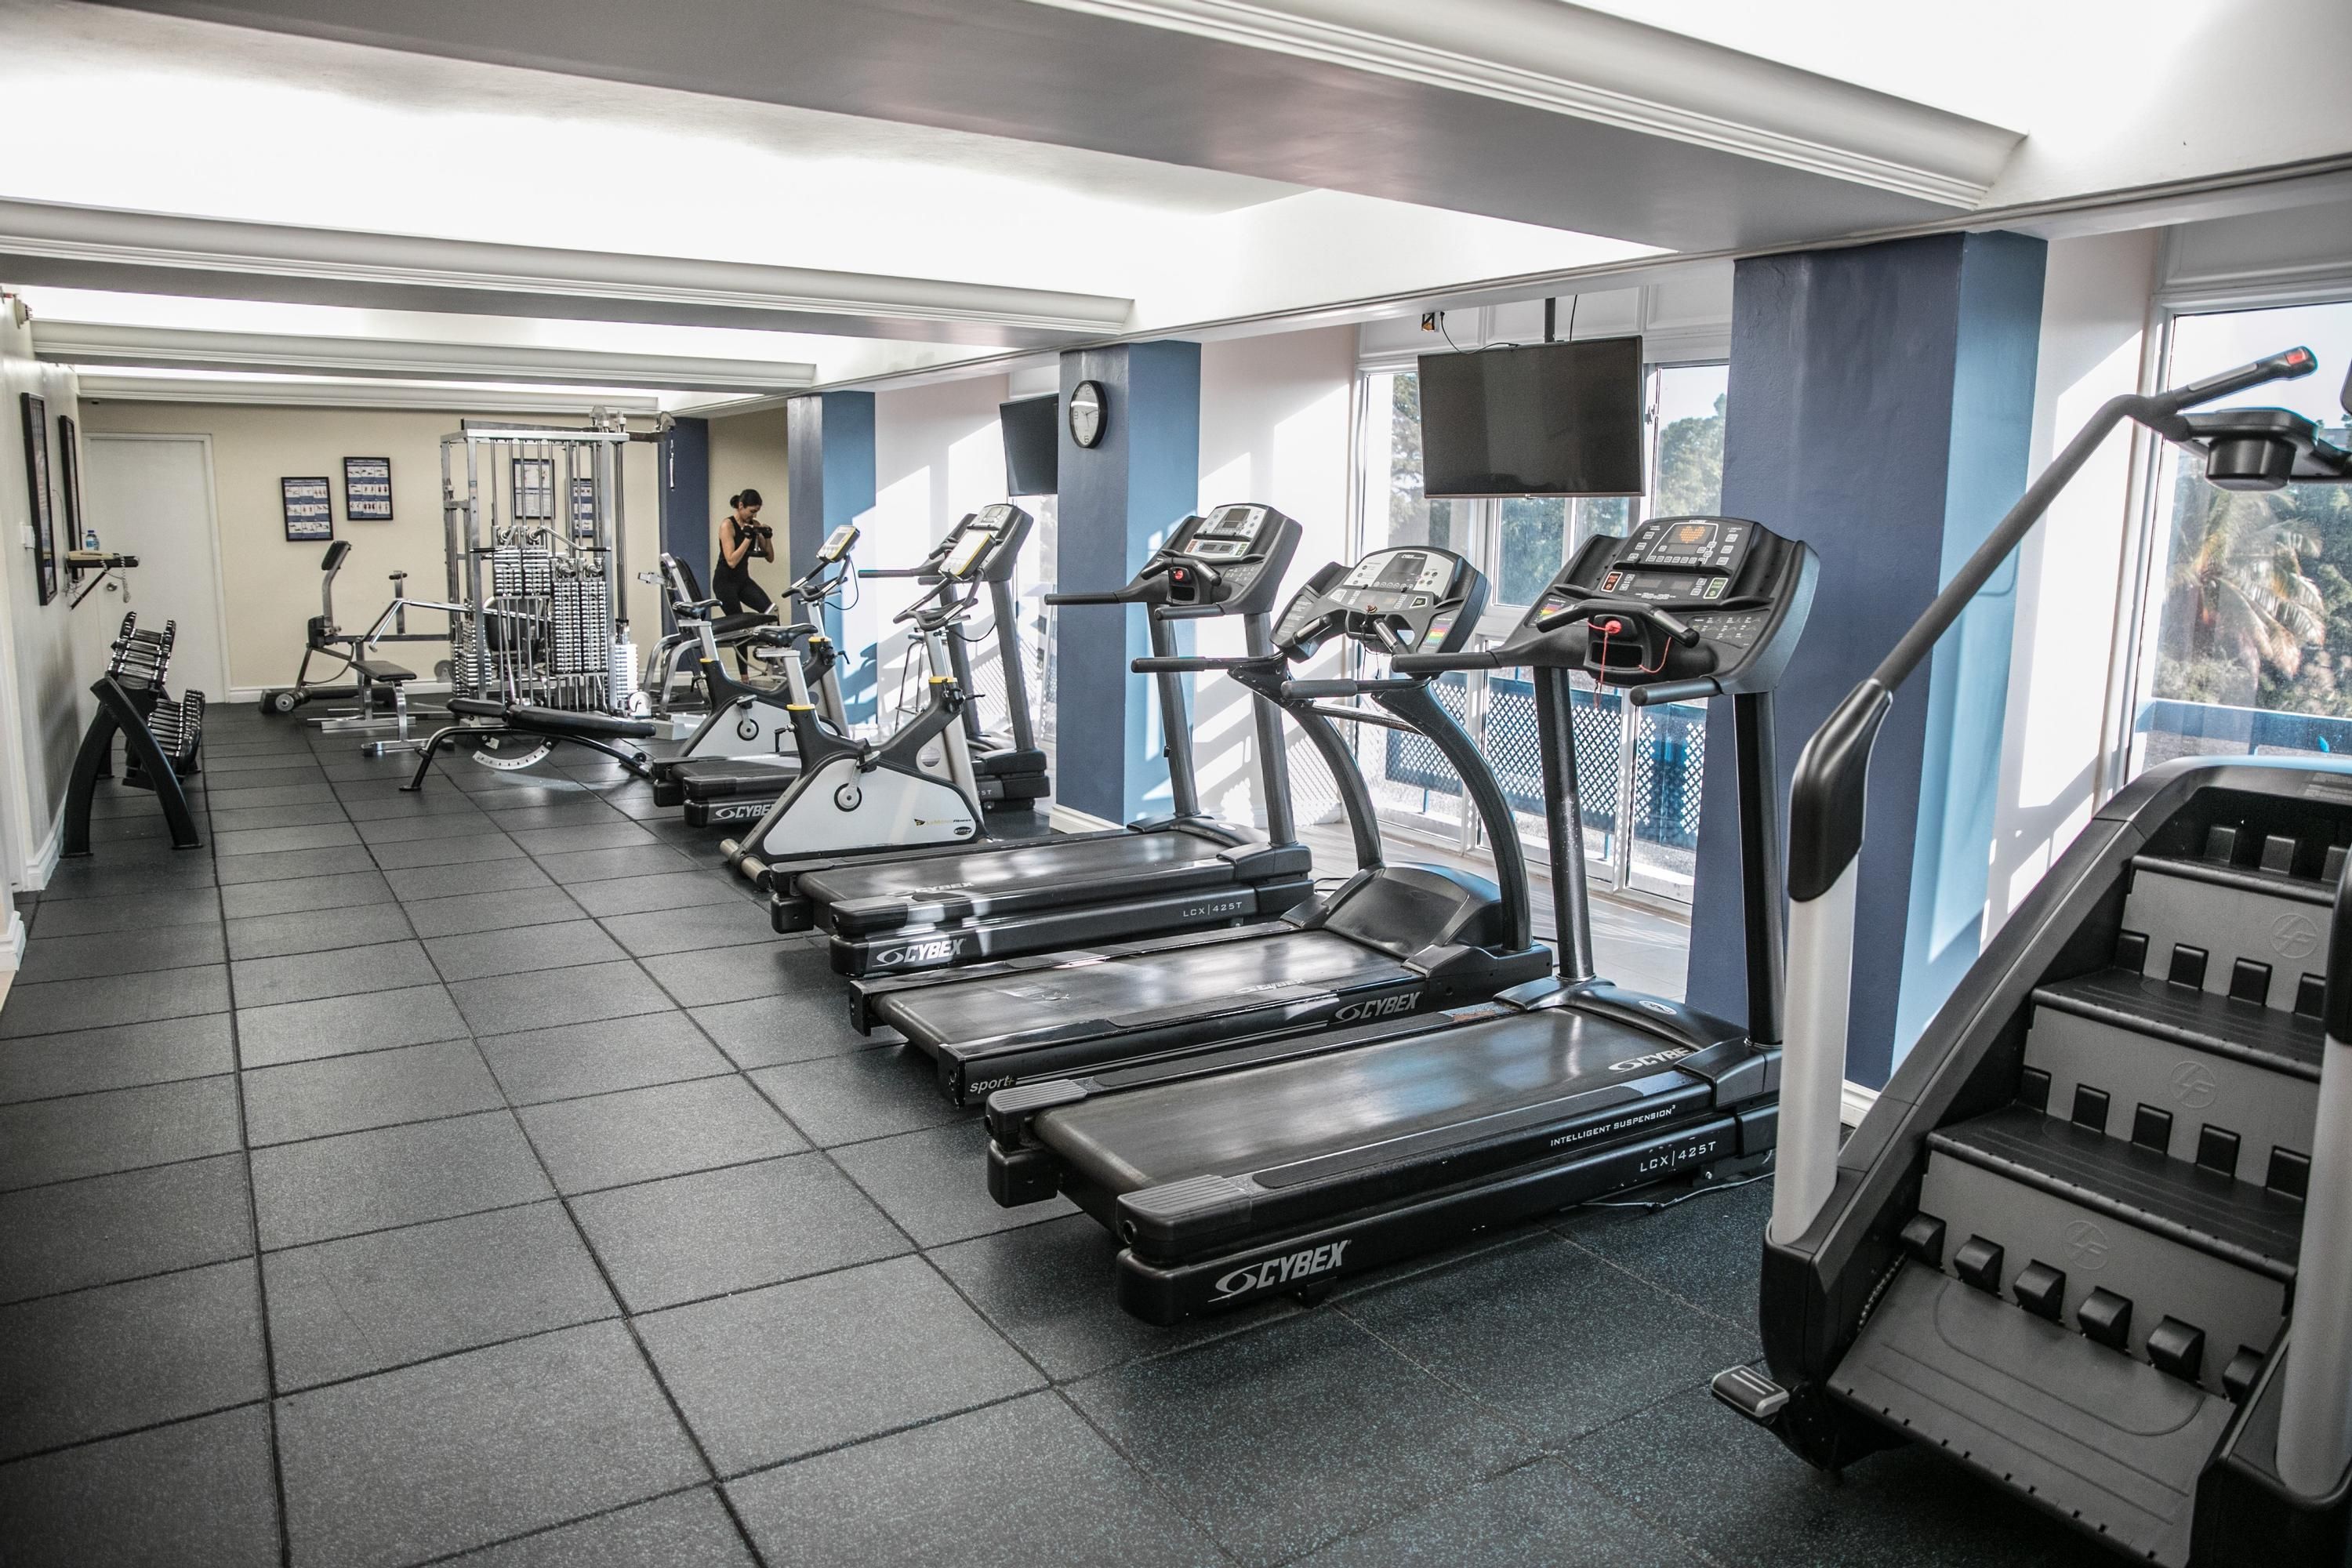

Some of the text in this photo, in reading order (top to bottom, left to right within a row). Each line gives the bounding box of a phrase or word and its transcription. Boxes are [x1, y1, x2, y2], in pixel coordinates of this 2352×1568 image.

[735, 803, 774, 818] CYBE
[903, 938, 966, 963] CYBEX
[1360, 991, 1421, 1019] CYBEX
[1637, 1047, 1693, 1066] CYBE
[1550, 1124, 1611, 1147] INTELLIGENT
[1256, 1240, 1349, 1290] CYBEX
